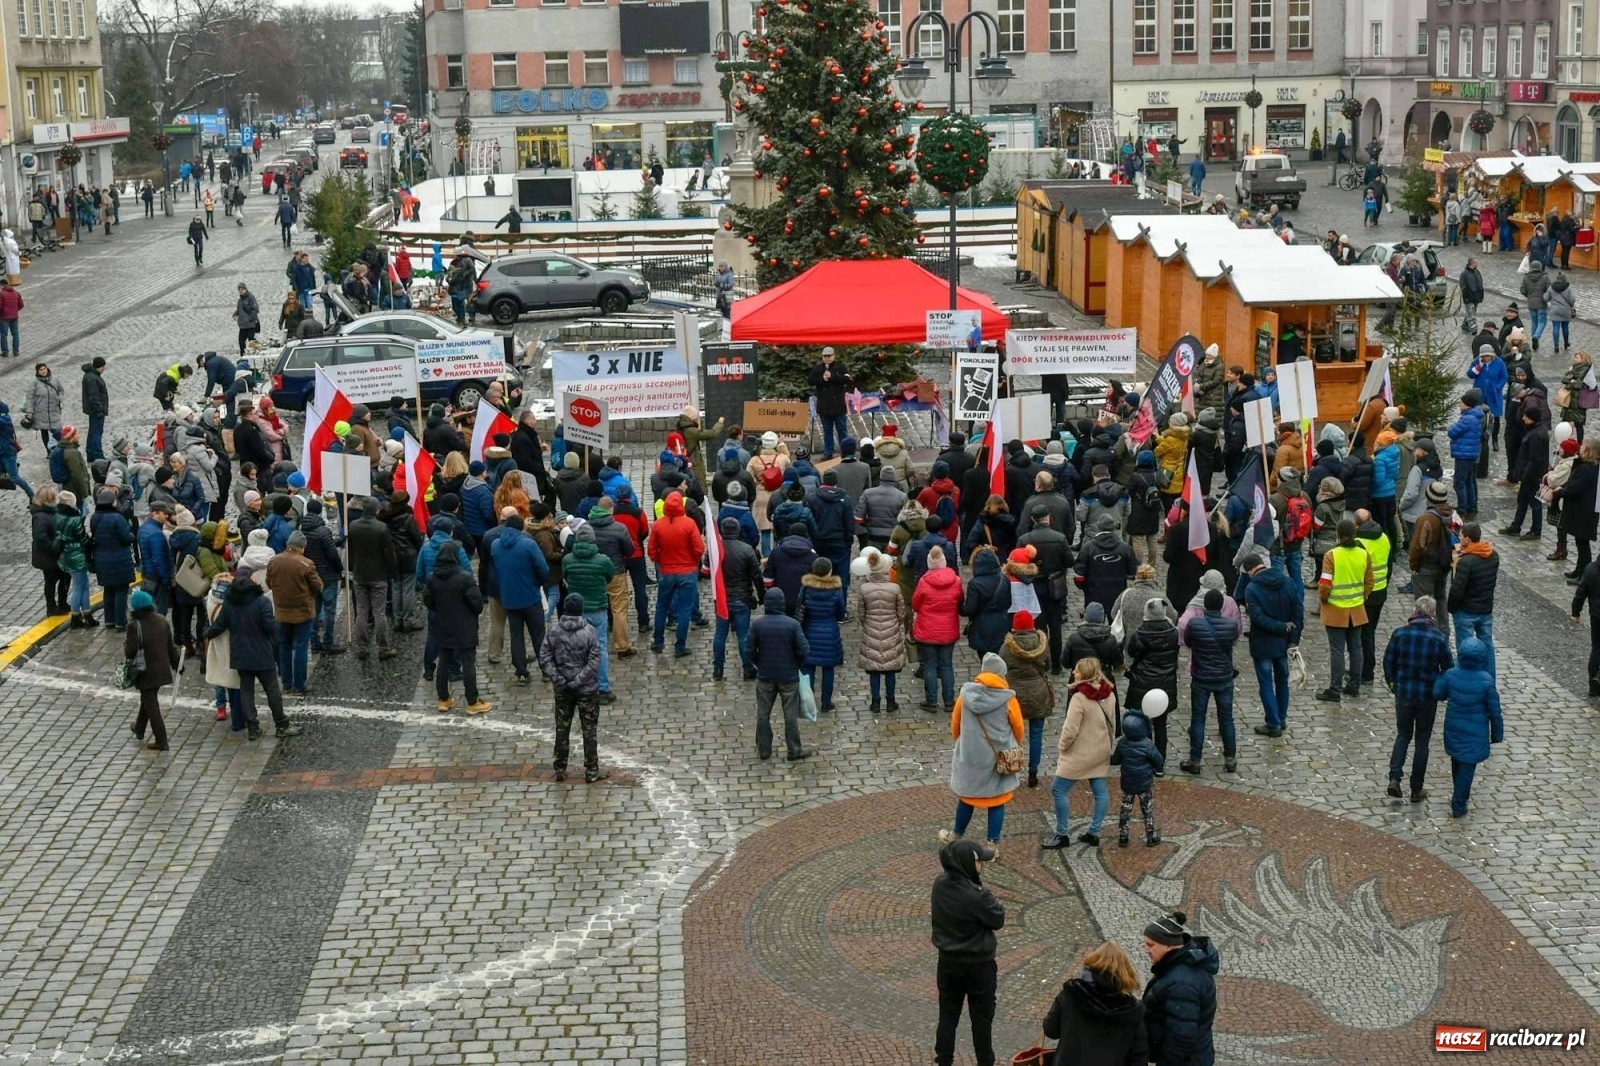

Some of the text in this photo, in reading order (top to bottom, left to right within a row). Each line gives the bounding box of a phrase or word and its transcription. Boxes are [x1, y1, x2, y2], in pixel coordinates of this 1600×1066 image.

[493, 88, 608, 113] BOLKO
[1040, 333, 1126, 341] NIESPRAWIEDLIWOŚĆ
[446, 339, 491, 348] MUNDUROWE
[1058, 345, 1069, 353] SIĘ
[447, 354, 479, 362] ZDROWIA
[1059, 355, 1070, 363] SIĘ
[1072, 355, 1132, 363] OBOWIĄZKIEM!
[586, 351, 664, 376] 3 x NIE
[445, 368, 504, 378] PRAWO WYBORU
[706, 363, 754, 376] NORYMBERGA
[566, 384, 582, 392] NIE
[600, 382, 642, 392] przymusu
[645, 379, 688, 389] szczepień
[647, 391, 690, 400] sanitarnej
[571, 405, 600, 418] STOP
[645, 403, 670, 412] dzieci
[766, 409, 796, 417] lidl-shop
